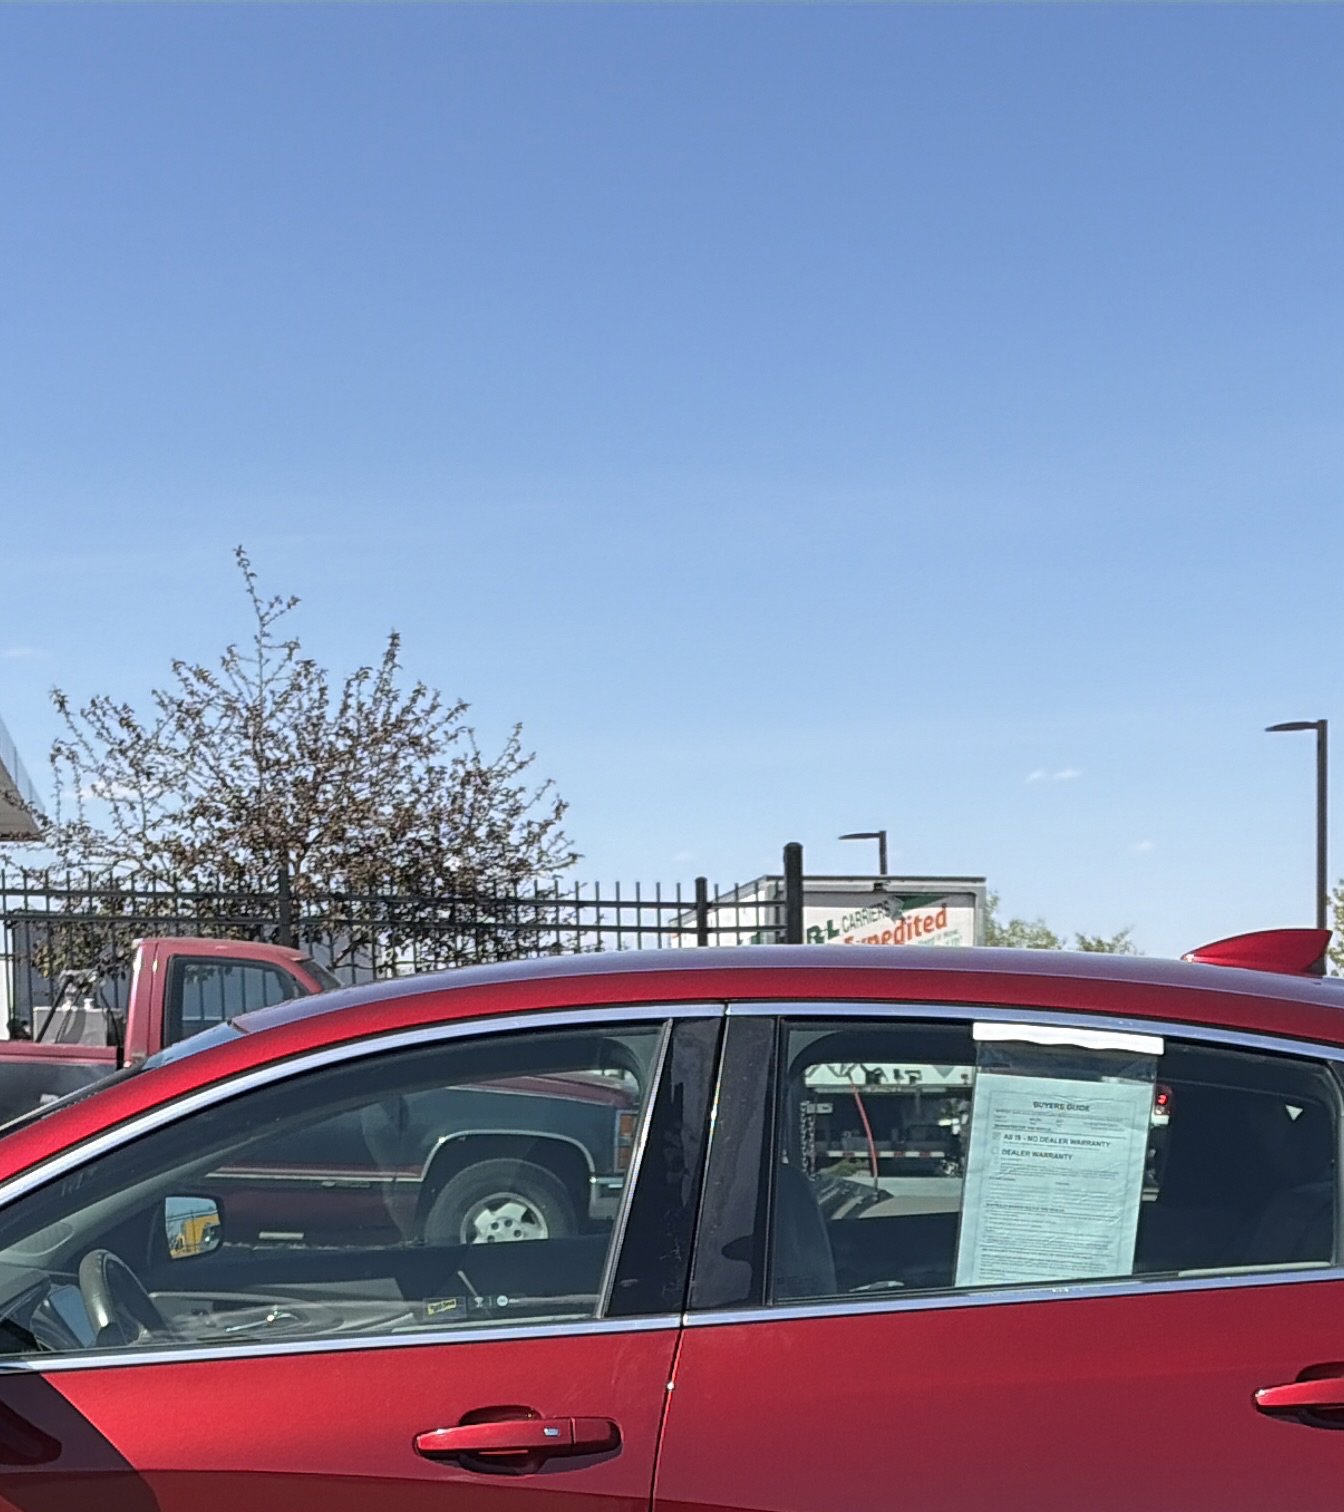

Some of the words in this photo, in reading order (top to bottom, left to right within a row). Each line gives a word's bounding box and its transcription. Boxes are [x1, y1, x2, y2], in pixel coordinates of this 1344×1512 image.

[842, 900, 890, 933] CARRIERS
[1032, 1101, 1065, 1110] BUYERS
[1039, 1136, 1069, 1144] DEALER
[1070, 1139, 1111, 1147] WARRANTY
[1001, 1149, 1031, 1157] DEALER
[1032, 1150, 1073, 1160] WARRANTY
